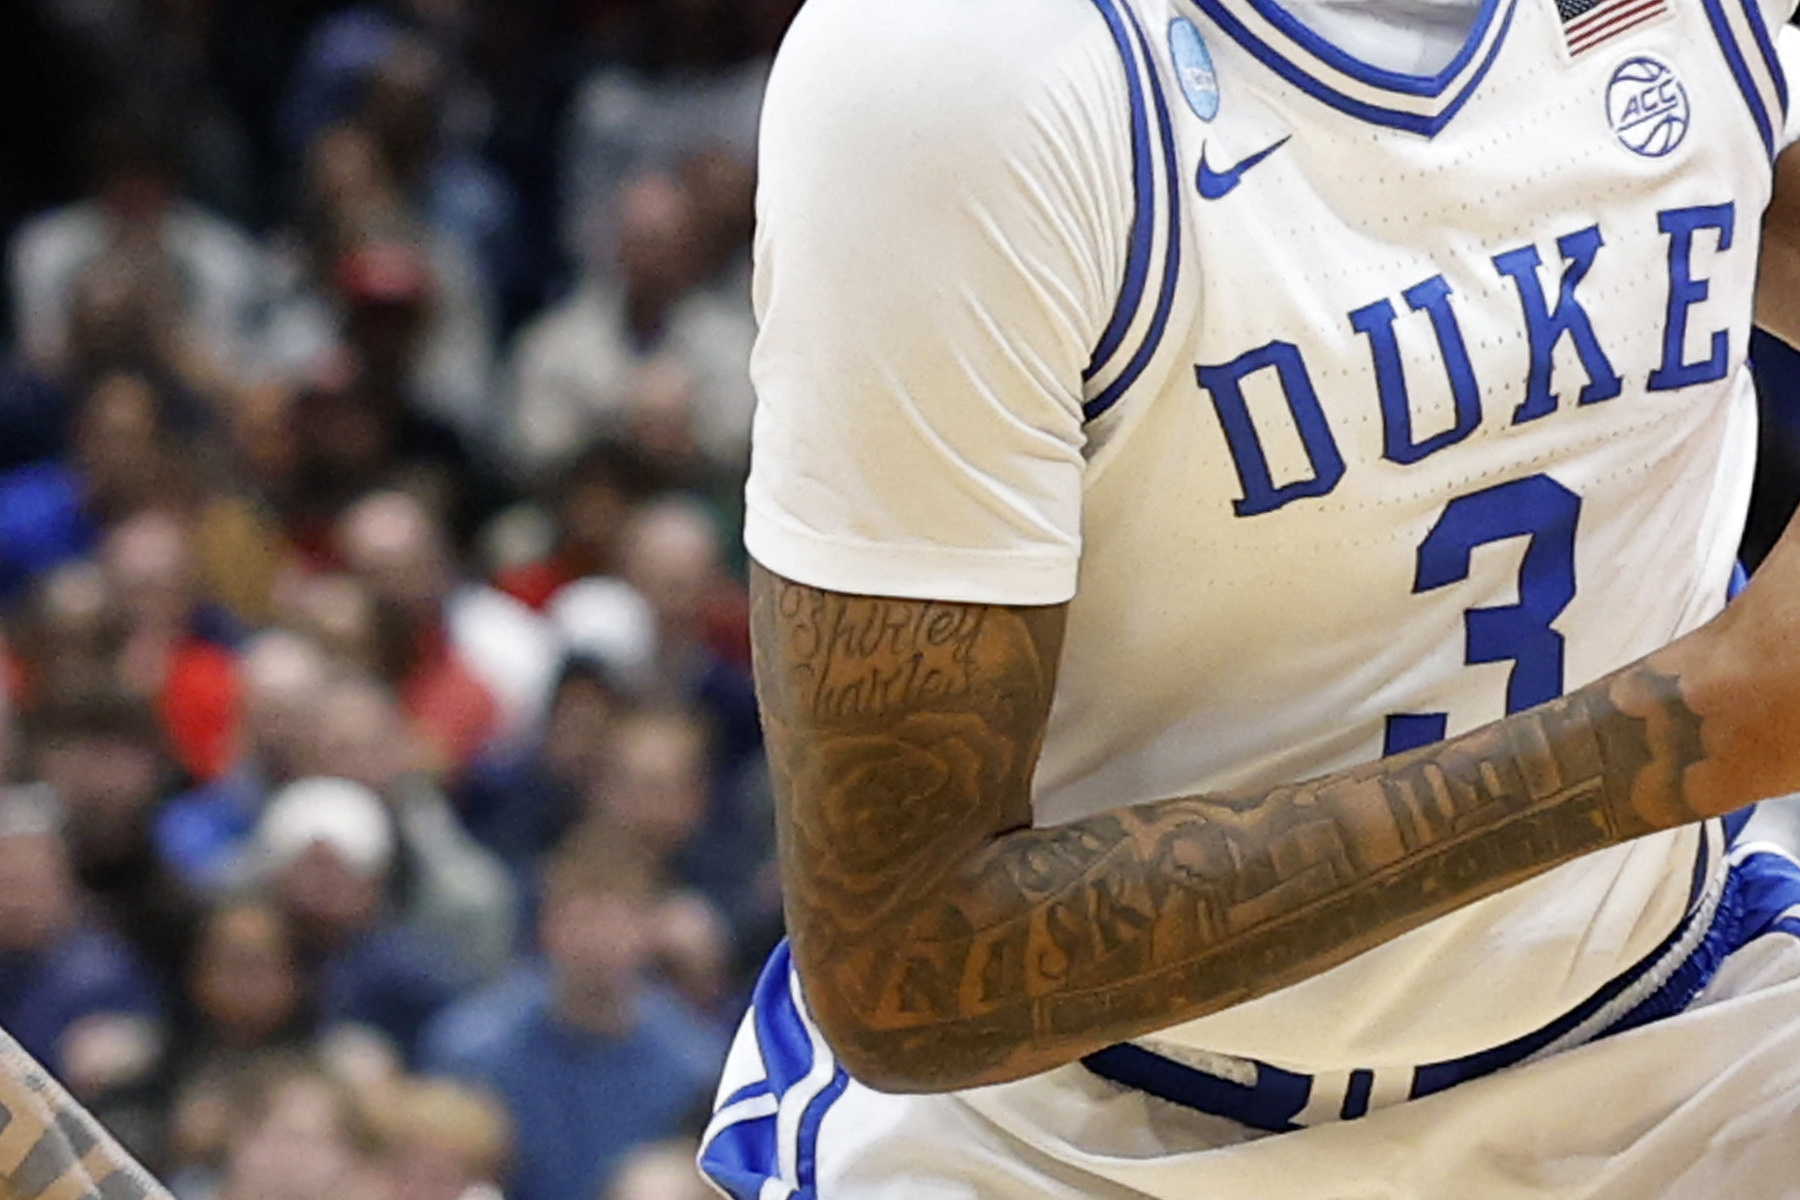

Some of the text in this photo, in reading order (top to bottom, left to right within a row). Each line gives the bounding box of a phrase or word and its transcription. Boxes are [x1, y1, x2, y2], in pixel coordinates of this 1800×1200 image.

[1621, 76, 1676, 122] ACC
[1194, 201, 1735, 518] DUKE
[1382, 472, 1583, 758] 3
